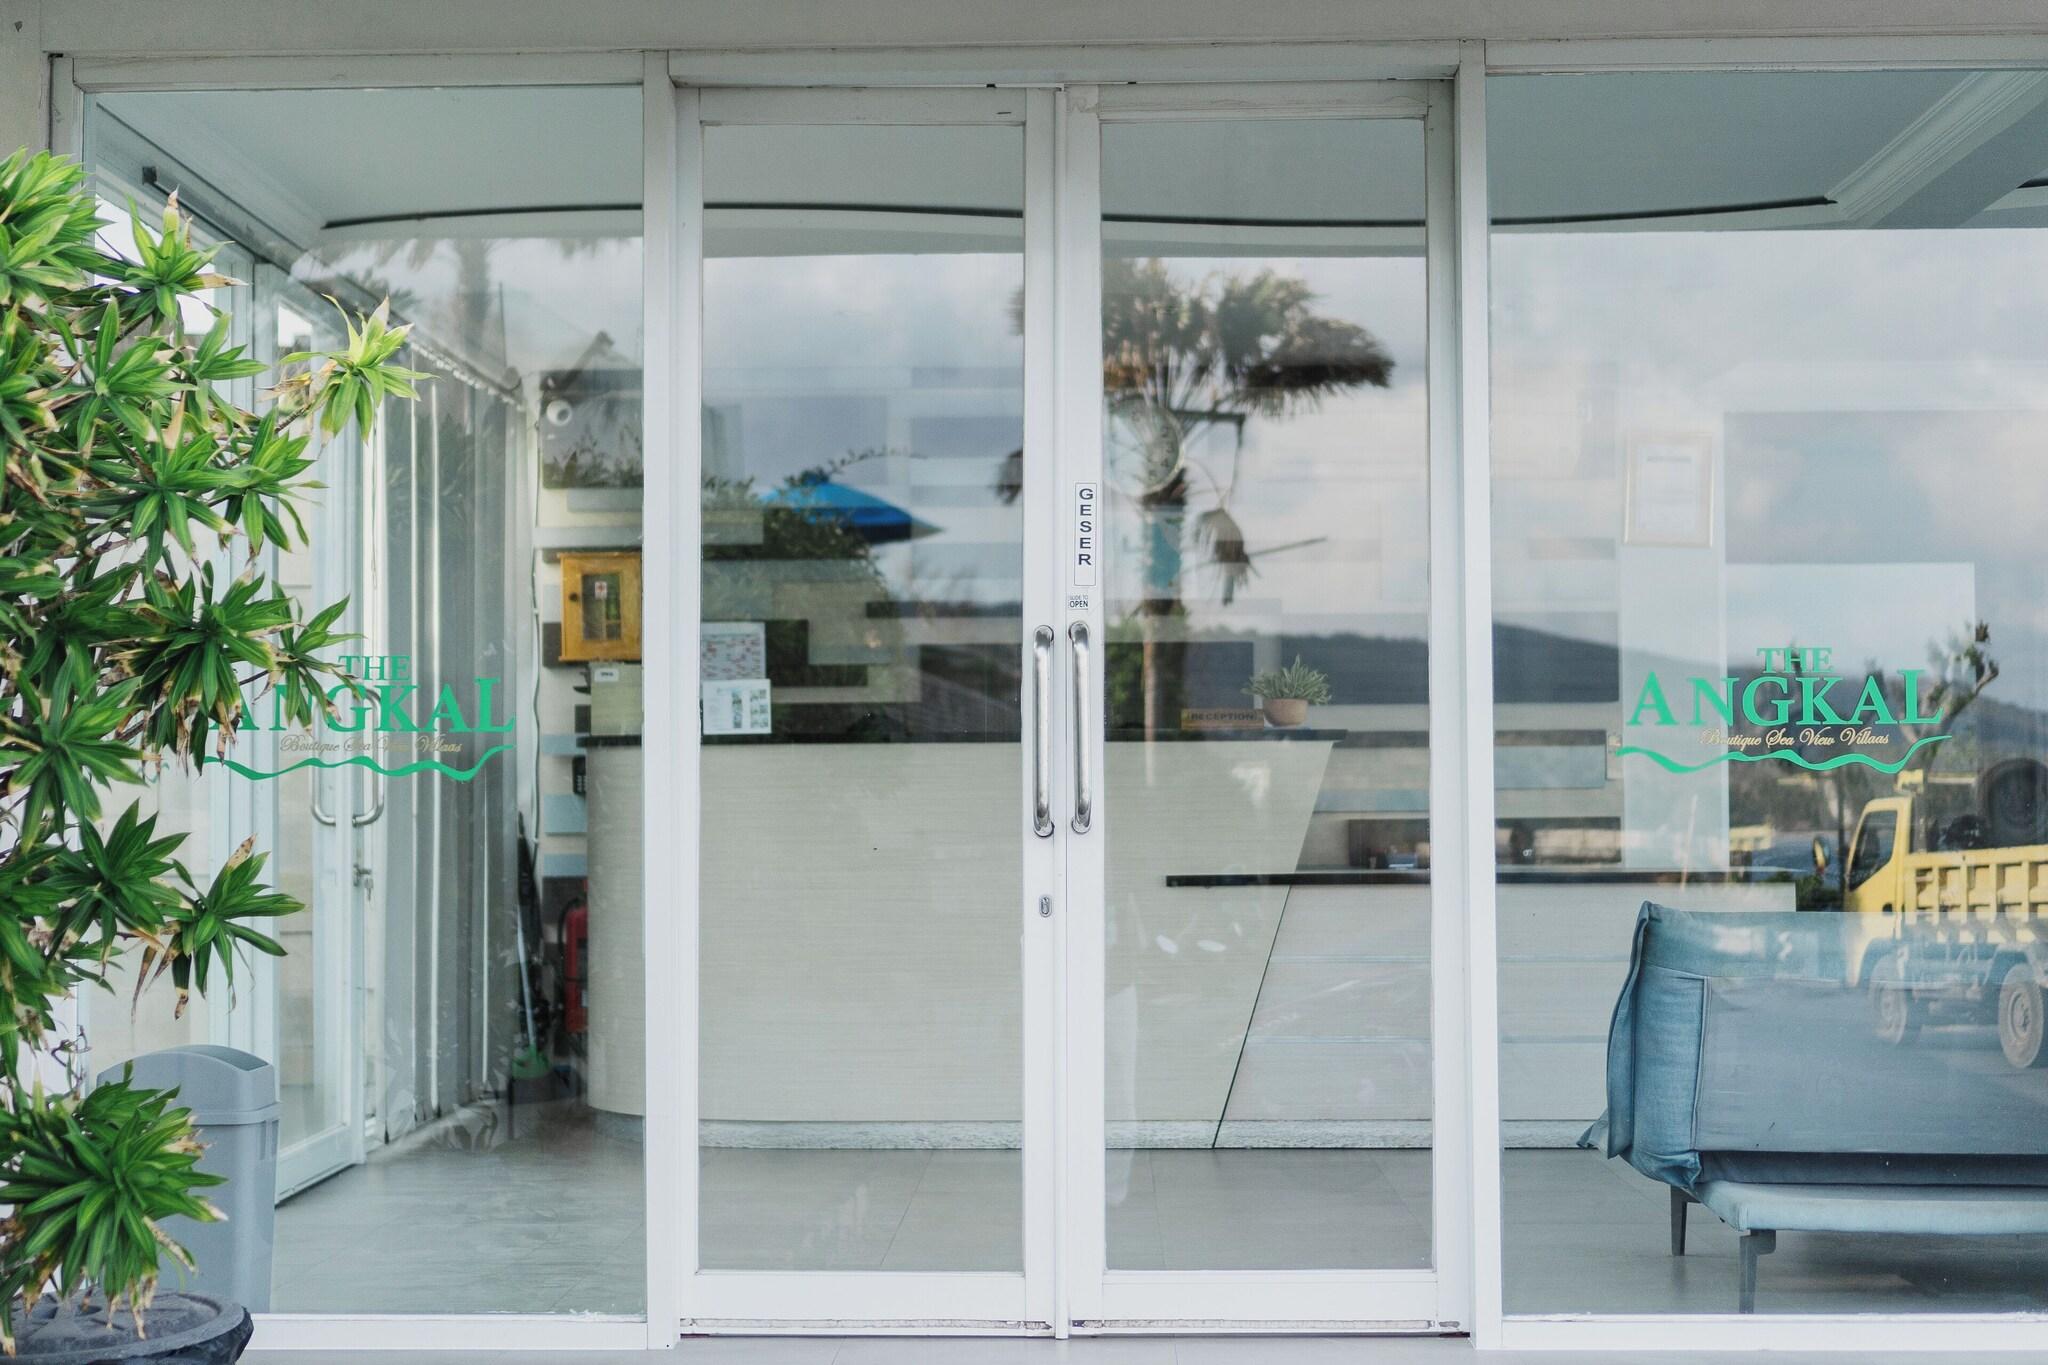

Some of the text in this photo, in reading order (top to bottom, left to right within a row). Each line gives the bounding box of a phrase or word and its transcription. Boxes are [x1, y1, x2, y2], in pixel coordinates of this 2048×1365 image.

[1078, 488, 1094, 566] GESER
[1069, 600, 1089, 608] OPEN
[338, 655, 411, 681] THE
[1757, 647, 1834, 674] THE
[1626, 669, 1945, 727] ANGKAL
[1190, 711, 1254, 721] RECEPTION
[280, 735, 340, 756] Boutique
[1701, 726, 1889, 751] Boutique Sea View Villaas
